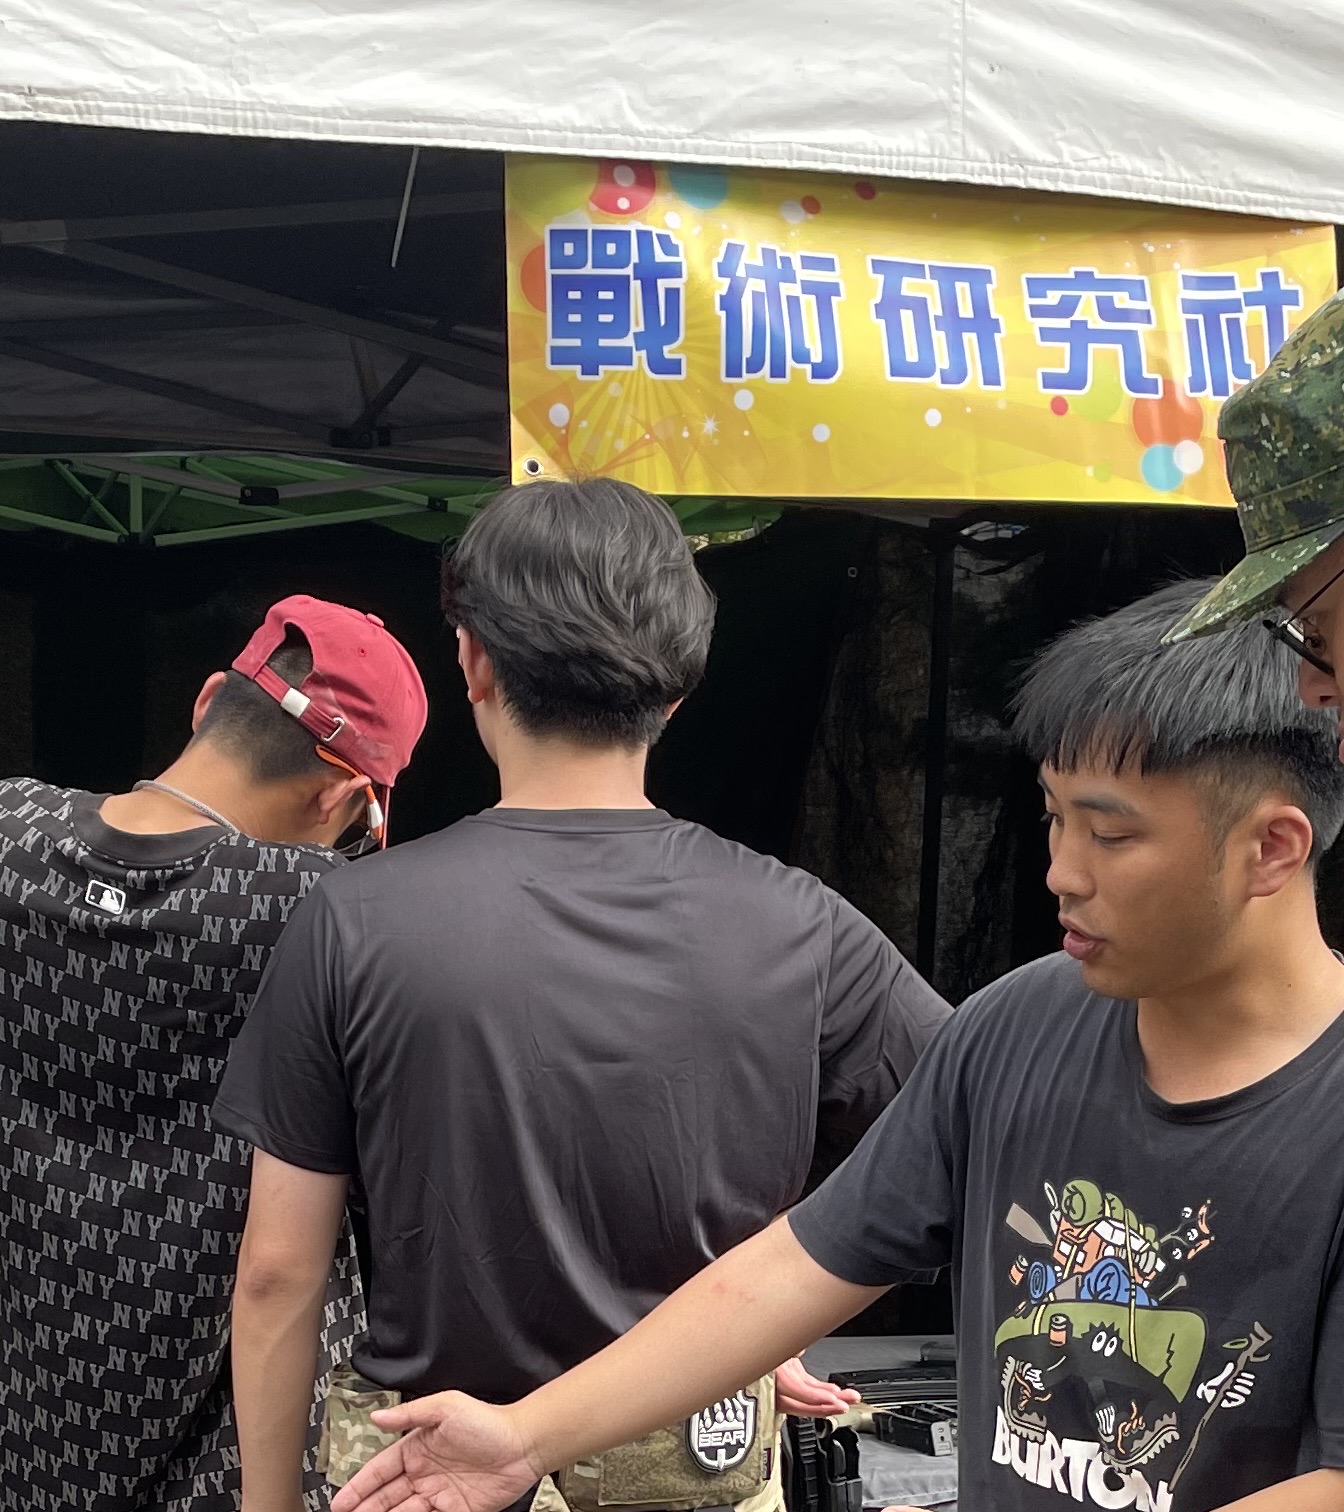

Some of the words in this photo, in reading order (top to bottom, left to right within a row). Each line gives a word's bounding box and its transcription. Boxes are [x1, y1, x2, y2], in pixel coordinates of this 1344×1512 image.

[544, 222, 1303, 399] 戰術研究社
[13, 802, 48, 823] NY
[18, 827, 57, 863] NY
[256, 848, 301, 872] NY
[41, 868, 84, 904] NY
[126, 870, 173, 891] NY
[211, 868, 253, 895] NY
[162, 891, 207, 913] NY
[252, 895, 295, 922] NY
[29, 909, 68, 946] NY
[69, 906, 110, 938] NY
[202, 916, 247, 944] NY
[110, 943, 151, 974] NY
[155, 933, 197, 962] NY
[26, 957, 63, 993] NY
[66, 949, 107, 984] NY
[193, 965, 237, 992] NY
[102, 986, 143, 1021] NY
[146, 978, 189, 1007] NY
[23, 1005, 58, 1041] NY
[61, 997, 99, 1031] NY
[186, 1011, 230, 1037] NY
[97, 1035, 137, 1067] NY
[140, 1023, 183, 1053] NY
[22, 1053, 56, 1087] NY
[58, 1045, 96, 1077] NY
[181, 1055, 224, 1083] NY
[97, 1081, 135, 1111] NY
[137, 1070, 179, 1098] NY
[18, 1100, 56, 1134] NY
[58, 1090, 96, 1122] NY
[96, 1126, 134, 1157] NY
[136, 1115, 176, 1144] NY
[13, 1147, 51, 1182] NY
[56, 1138, 94, 1170] NY
[171, 1148, 211, 1180] NY
[213, 1134, 254, 1165] NY
[88, 1175, 126, 1207] NY
[129, 1160, 167, 1192] NY
[11, 1195, 43, 1229] NY
[46, 1188, 84, 1218] NY
[207, 1182, 248, 1211] NY
[123, 1211, 162, 1241] NY
[165, 1198, 204, 1227] NY
[42, 1232, 78, 1264] NY
[80, 1221, 119, 1254] NY
[201, 1230, 241, 1255] NY
[10, 1241, 41, 1274] NY
[116, 1256, 155, 1287] NY
[158, 1244, 198, 1273] NY
[38, 1277, 75, 1309] NY
[77, 1268, 114, 1300] NY
[197, 1273, 234, 1298] NY
[10, 1287, 36, 1320] NY
[113, 1302, 151, 1333] NY
[154, 1289, 193, 1317] NY
[324, 1298, 350, 1323] NY
[13, 1326, 34, 1360] NY
[150, 1335, 190, 1363] NY
[330, 1335, 353, 1363] NY
[67, 1357, 105, 1388] NY
[108, 1345, 147, 1375] NY
[188, 1352, 220, 1377] NY
[11, 1368, 35, 1401] NY
[36, 1361, 65, 1396] NY
[145, 1376, 186, 1400] NY
[65, 1398, 102, 1430] NY
[103, 1389, 142, 1417] NY
[8, 1408, 33, 1442] NY
[34, 1404, 63, 1438] NY
[142, 1417, 178, 1439] NY
[101, 1431, 140, 1458] NY
[698, 1429, 746, 1448] BEAR
[5, 1449, 33, 1480] NY
[33, 1445, 61, 1478] NY
[63, 1439, 99, 1470] NY
[62, 1480, 97, 1511] NY
[99, 1473, 137, 1497] NY
[193, 1471, 224, 1495] NY
